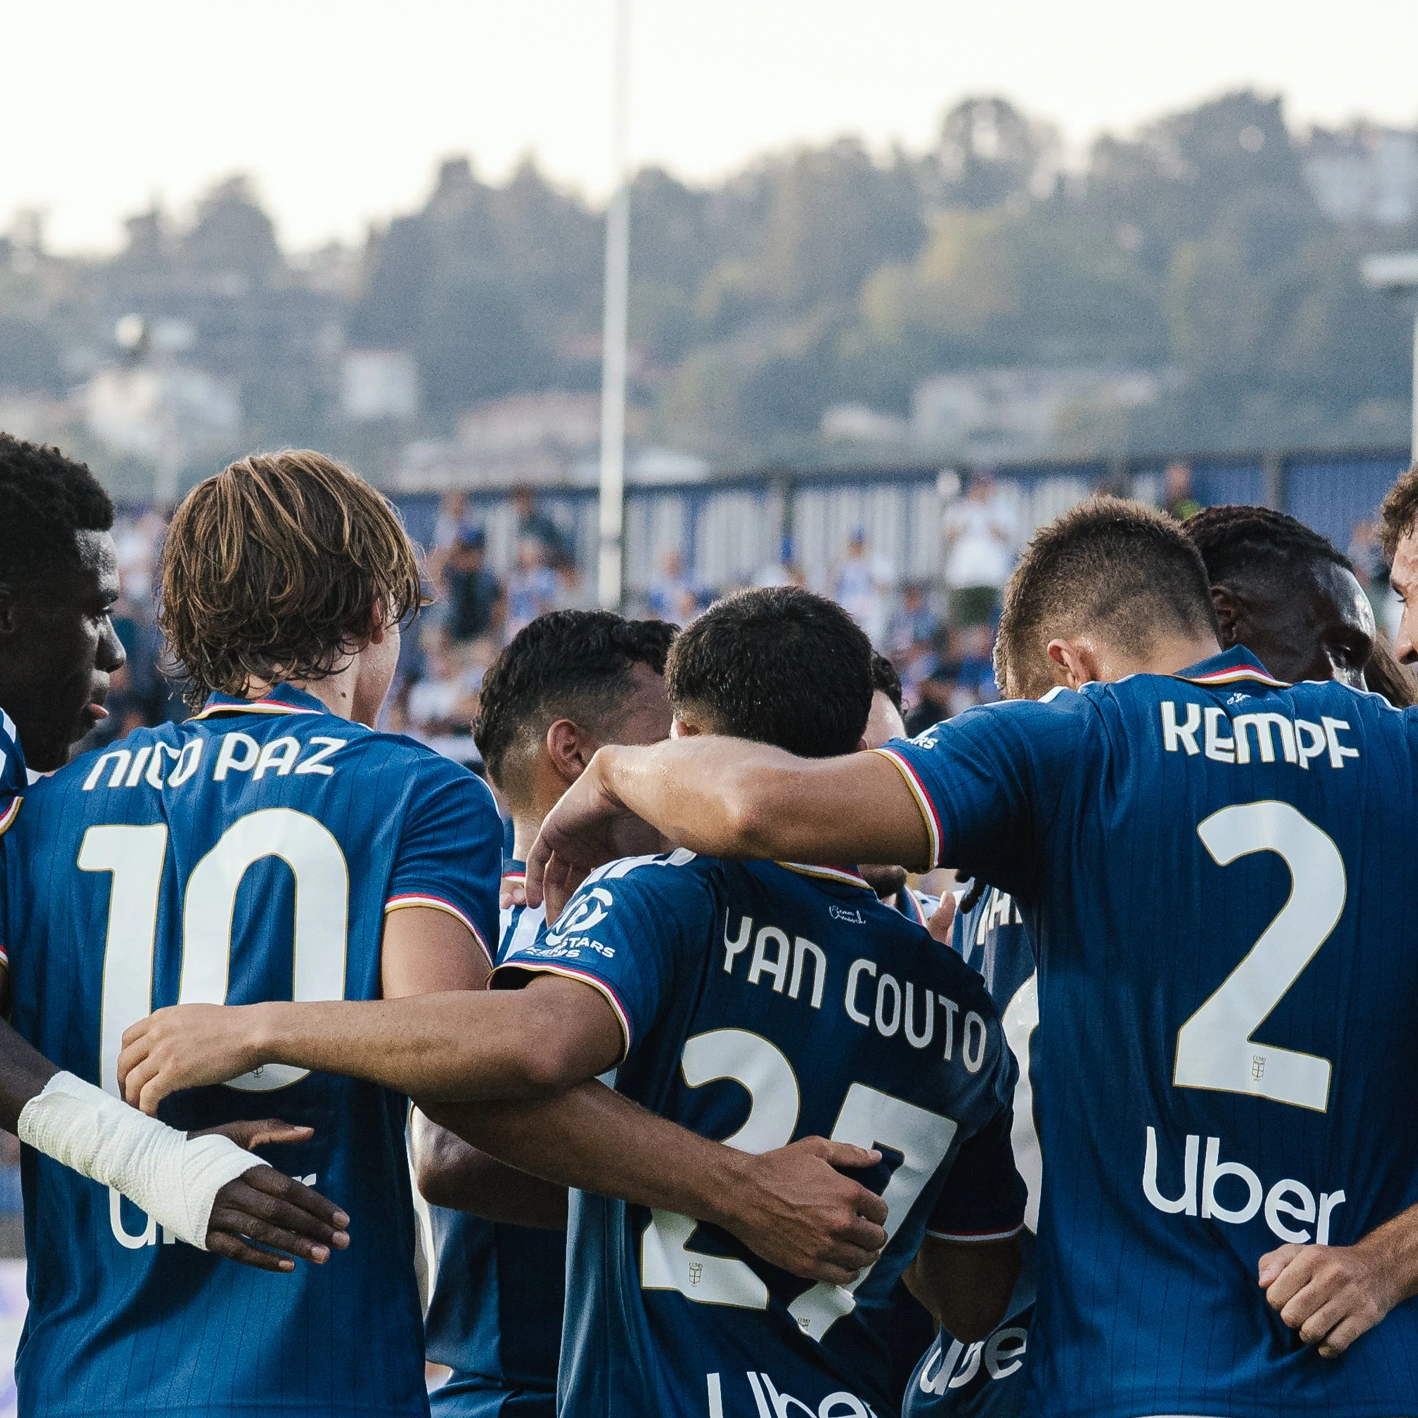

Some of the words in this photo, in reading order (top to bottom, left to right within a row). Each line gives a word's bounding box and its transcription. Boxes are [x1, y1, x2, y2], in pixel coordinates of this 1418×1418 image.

[213, 732, 347, 781] PAZ
[1161, 701, 1360, 770] KEMPF
[77, 807, 349, 1092] 10
[723, 906, 827, 1010] YAN
[844, 958, 987, 1074] COUTO
[1173, 800, 1346, 1113] 2
[640, 1027, 958, 1343] 27
[1143, 1126, 1346, 1246] Uber
